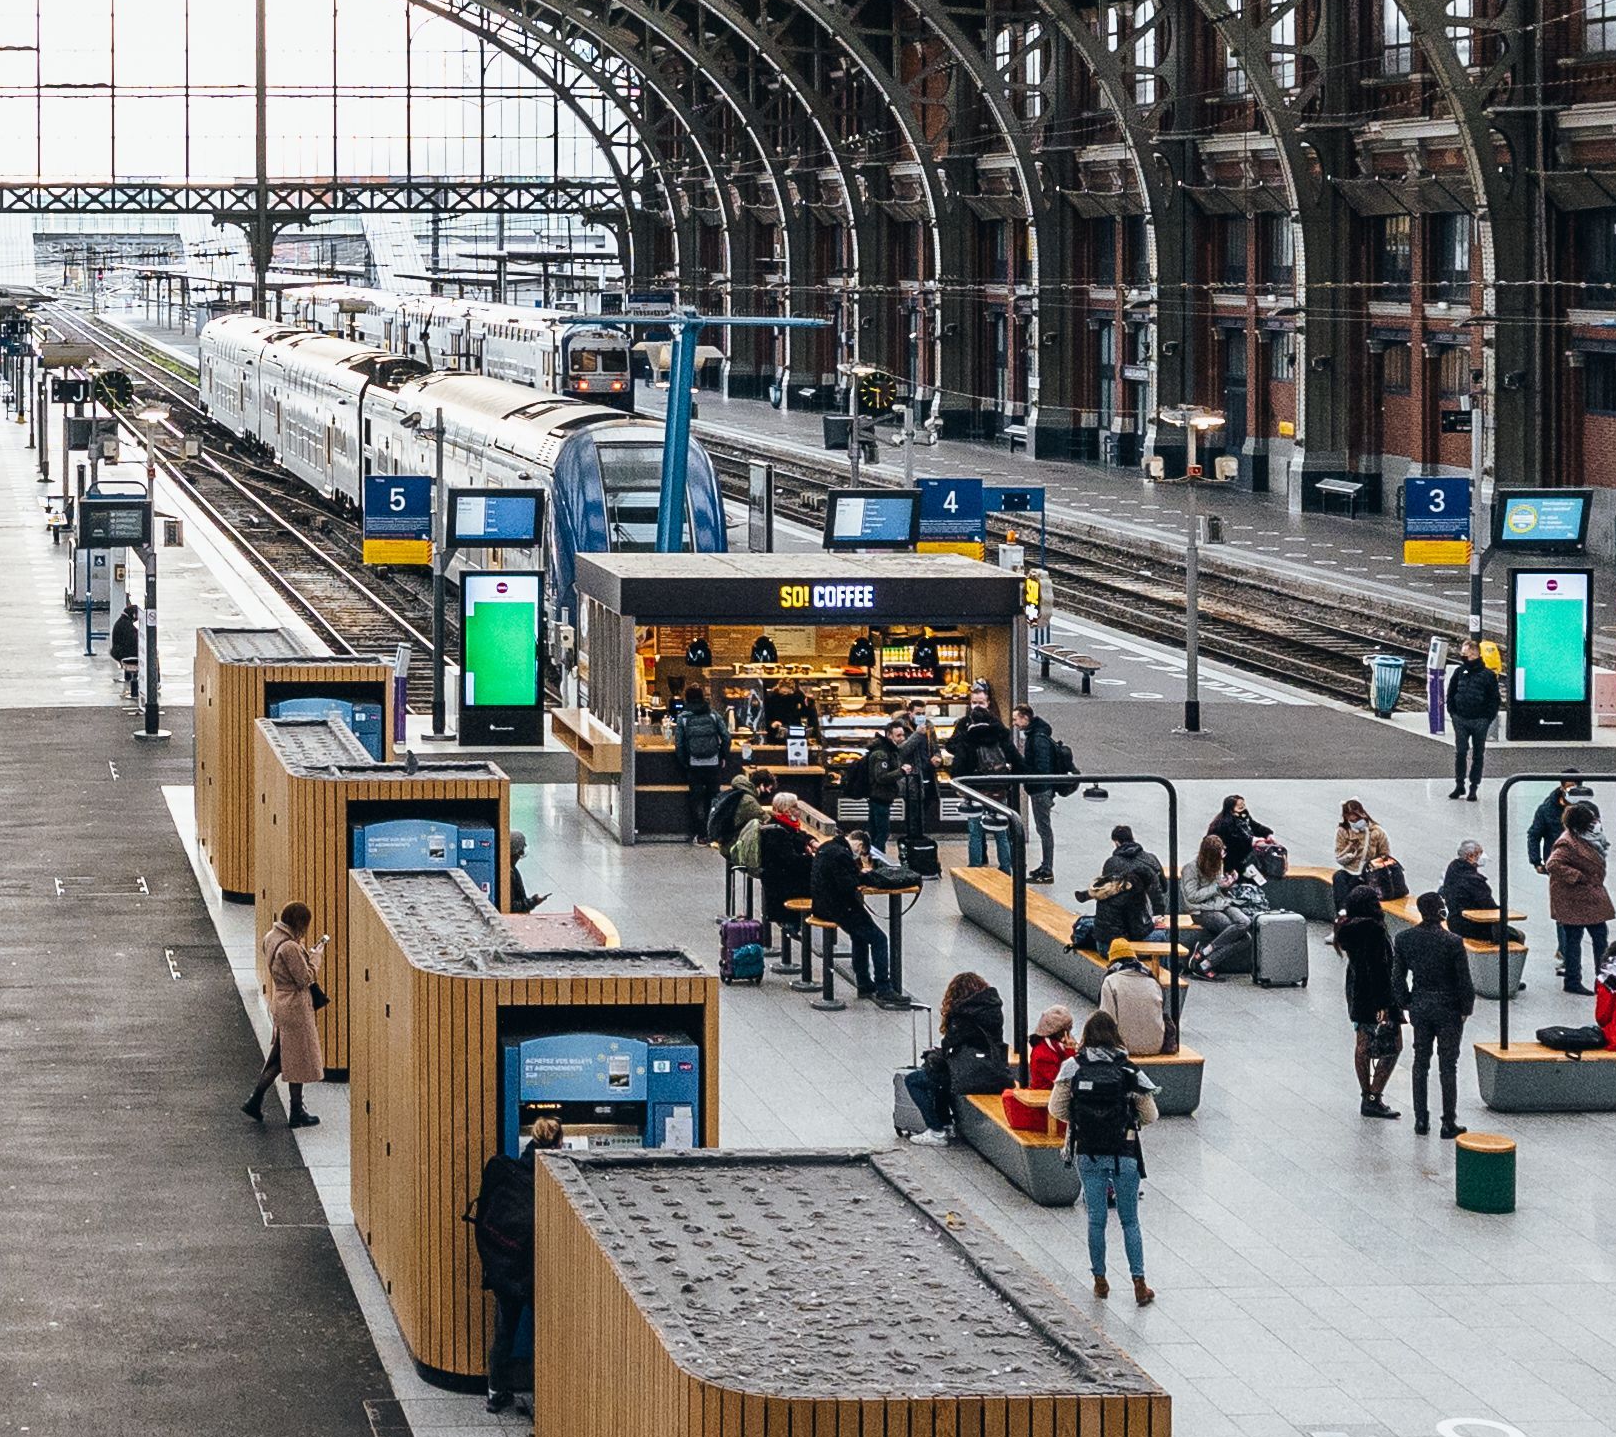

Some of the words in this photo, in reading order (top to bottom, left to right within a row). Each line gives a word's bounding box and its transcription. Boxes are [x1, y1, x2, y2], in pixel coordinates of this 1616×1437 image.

[18, 323, 27, 332] H
[72, 384, 84, 402] J
[389, 487, 407, 512] 5
[943, 490, 959, 514] 4
[1428, 488, 1446, 513] 3
[780, 586, 810, 609] SO!
[813, 586, 874, 608] COFFEE
